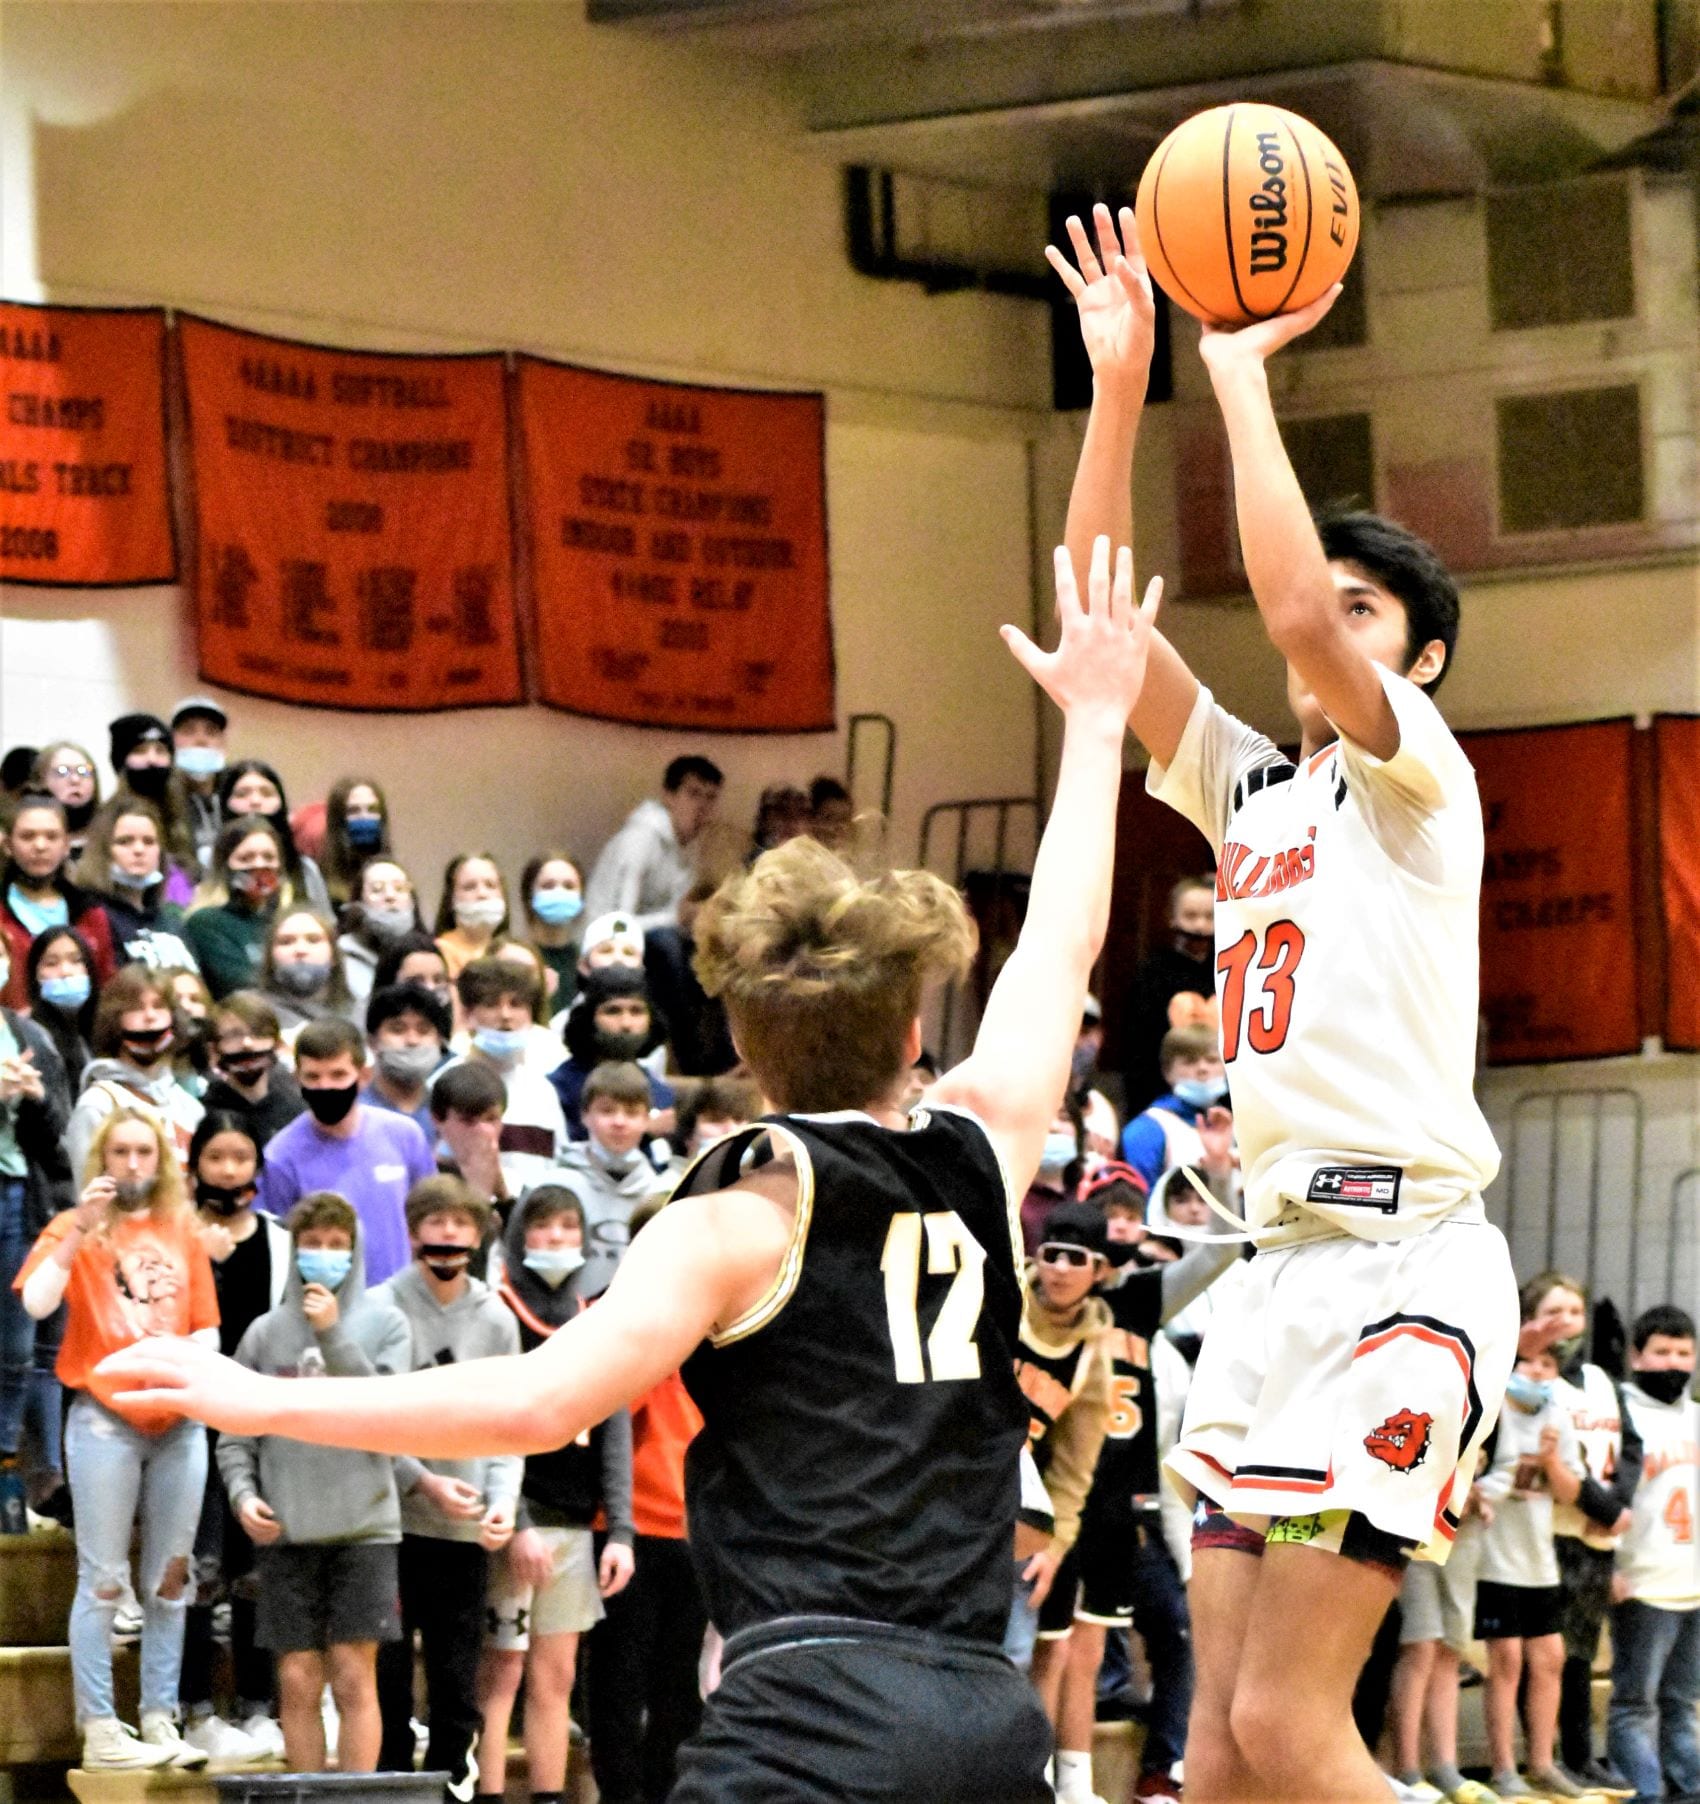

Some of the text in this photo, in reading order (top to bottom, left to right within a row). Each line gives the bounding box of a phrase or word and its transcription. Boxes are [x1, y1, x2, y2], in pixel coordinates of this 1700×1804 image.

[1249, 131, 1289, 277] Wilson
[8, 393, 106, 430] CHAMPS
[331, 373, 453, 410] SOFTBALL
[224, 414, 335, 467] DISTRICT
[53, 462, 133, 496] TRACK
[1217, 918, 1306, 1065] 13
[880, 1209, 988, 1384] 12
[1662, 1486, 1695, 1544] 4
